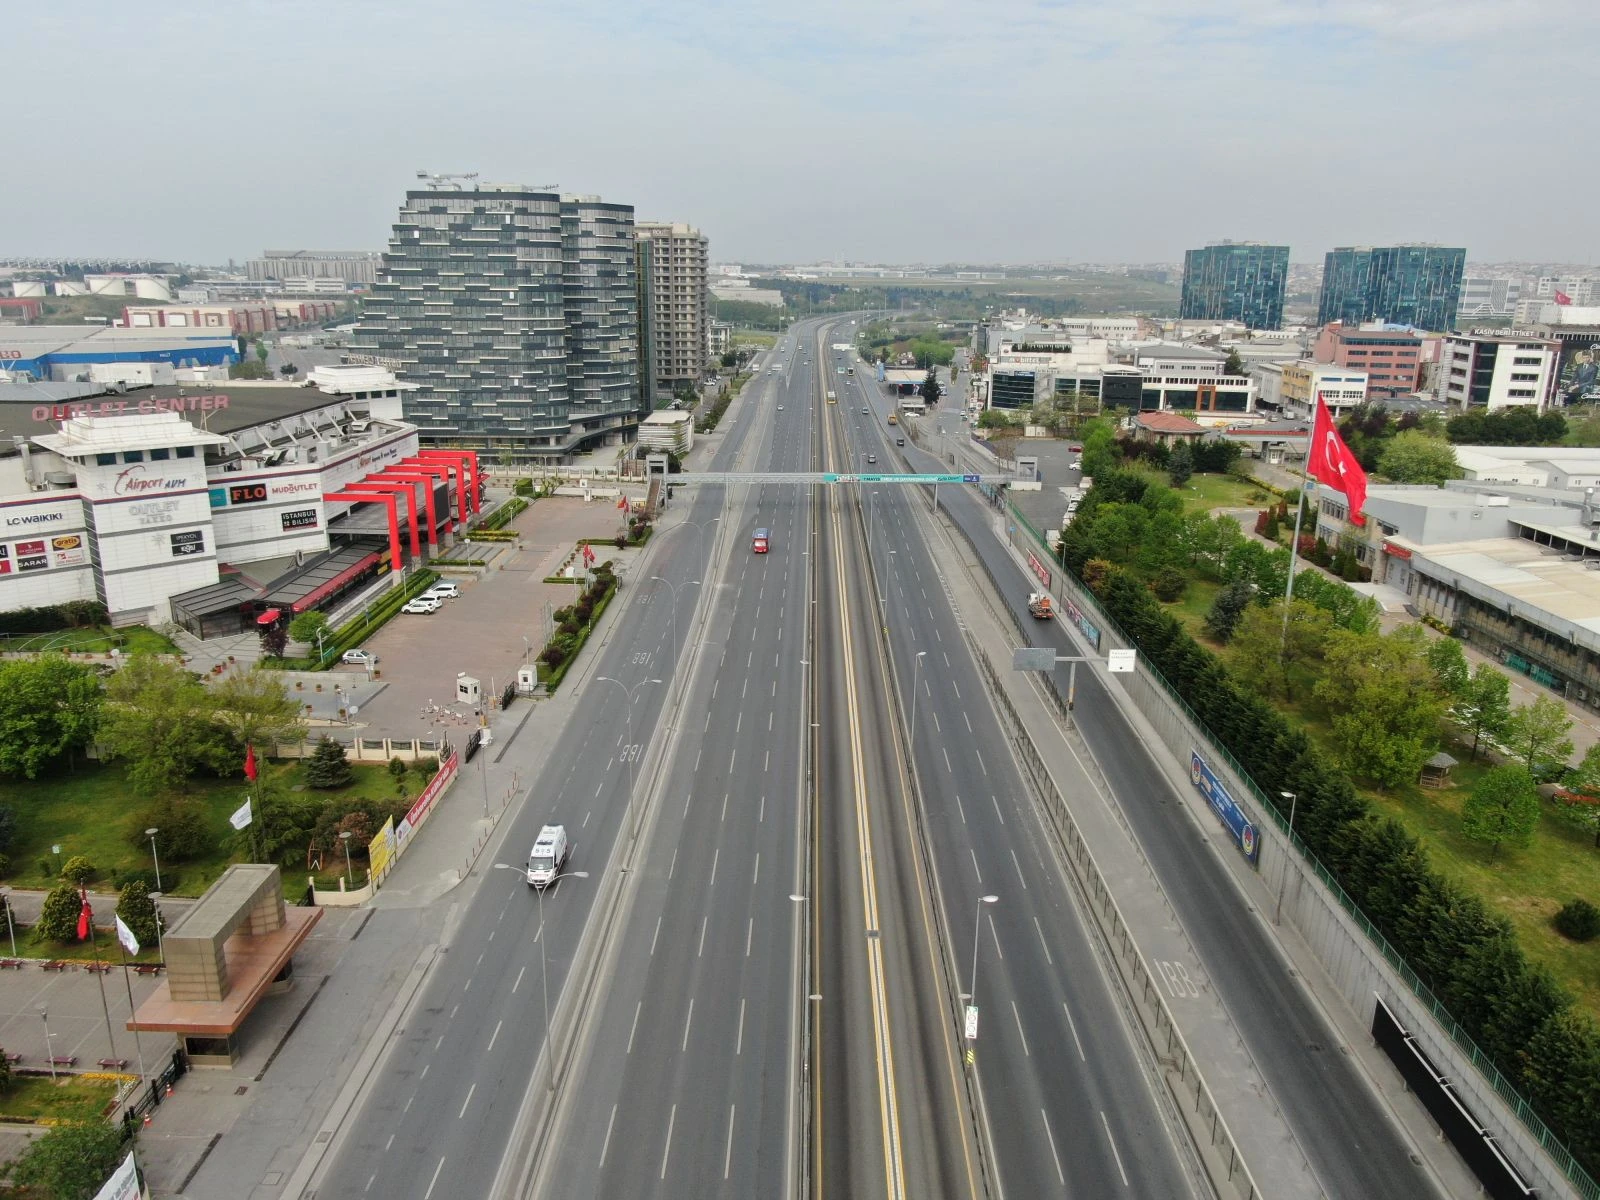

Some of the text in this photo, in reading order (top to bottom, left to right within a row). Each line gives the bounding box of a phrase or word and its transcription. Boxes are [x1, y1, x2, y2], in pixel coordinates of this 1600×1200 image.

[32, 395, 229, 421] OUTLET CENTER
[232, 486, 266, 500] FLO
[56, 537, 77, 547] gratis
[18, 559, 48, 568] SARAR
